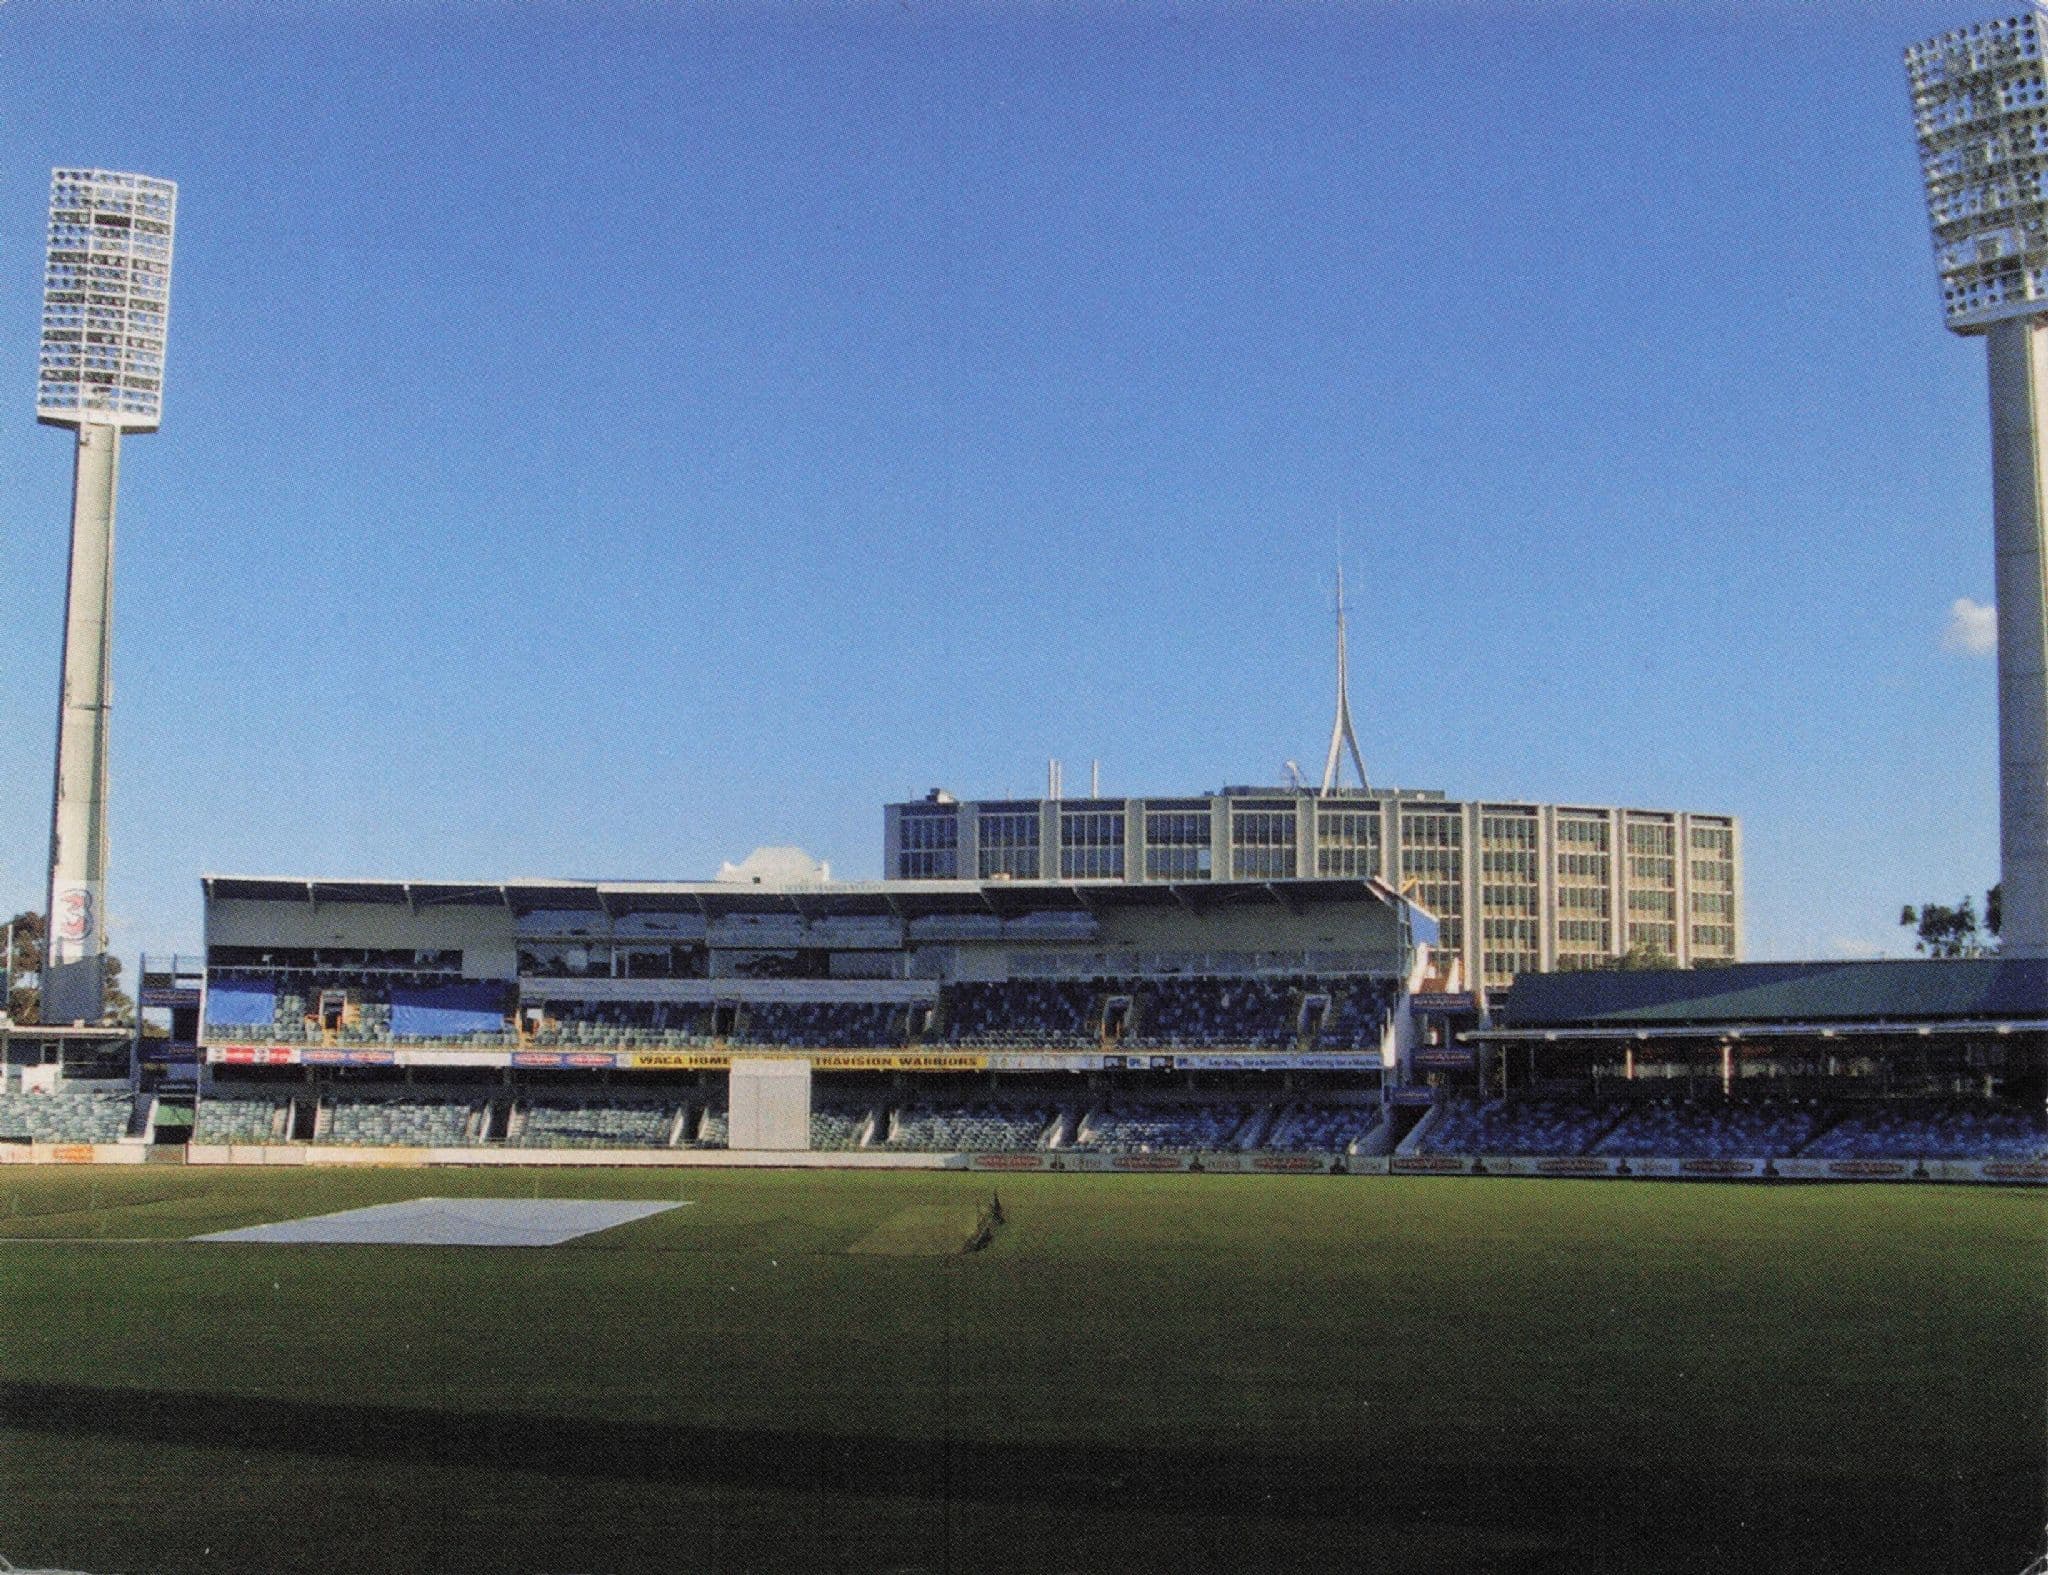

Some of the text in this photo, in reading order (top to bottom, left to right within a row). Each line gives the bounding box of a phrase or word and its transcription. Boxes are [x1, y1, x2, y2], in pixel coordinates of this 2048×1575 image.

[639, 1056, 683, 1065] WACA
[689, 1056, 729, 1065] HOME
[899, 1057, 978, 1066] WARRIORS
